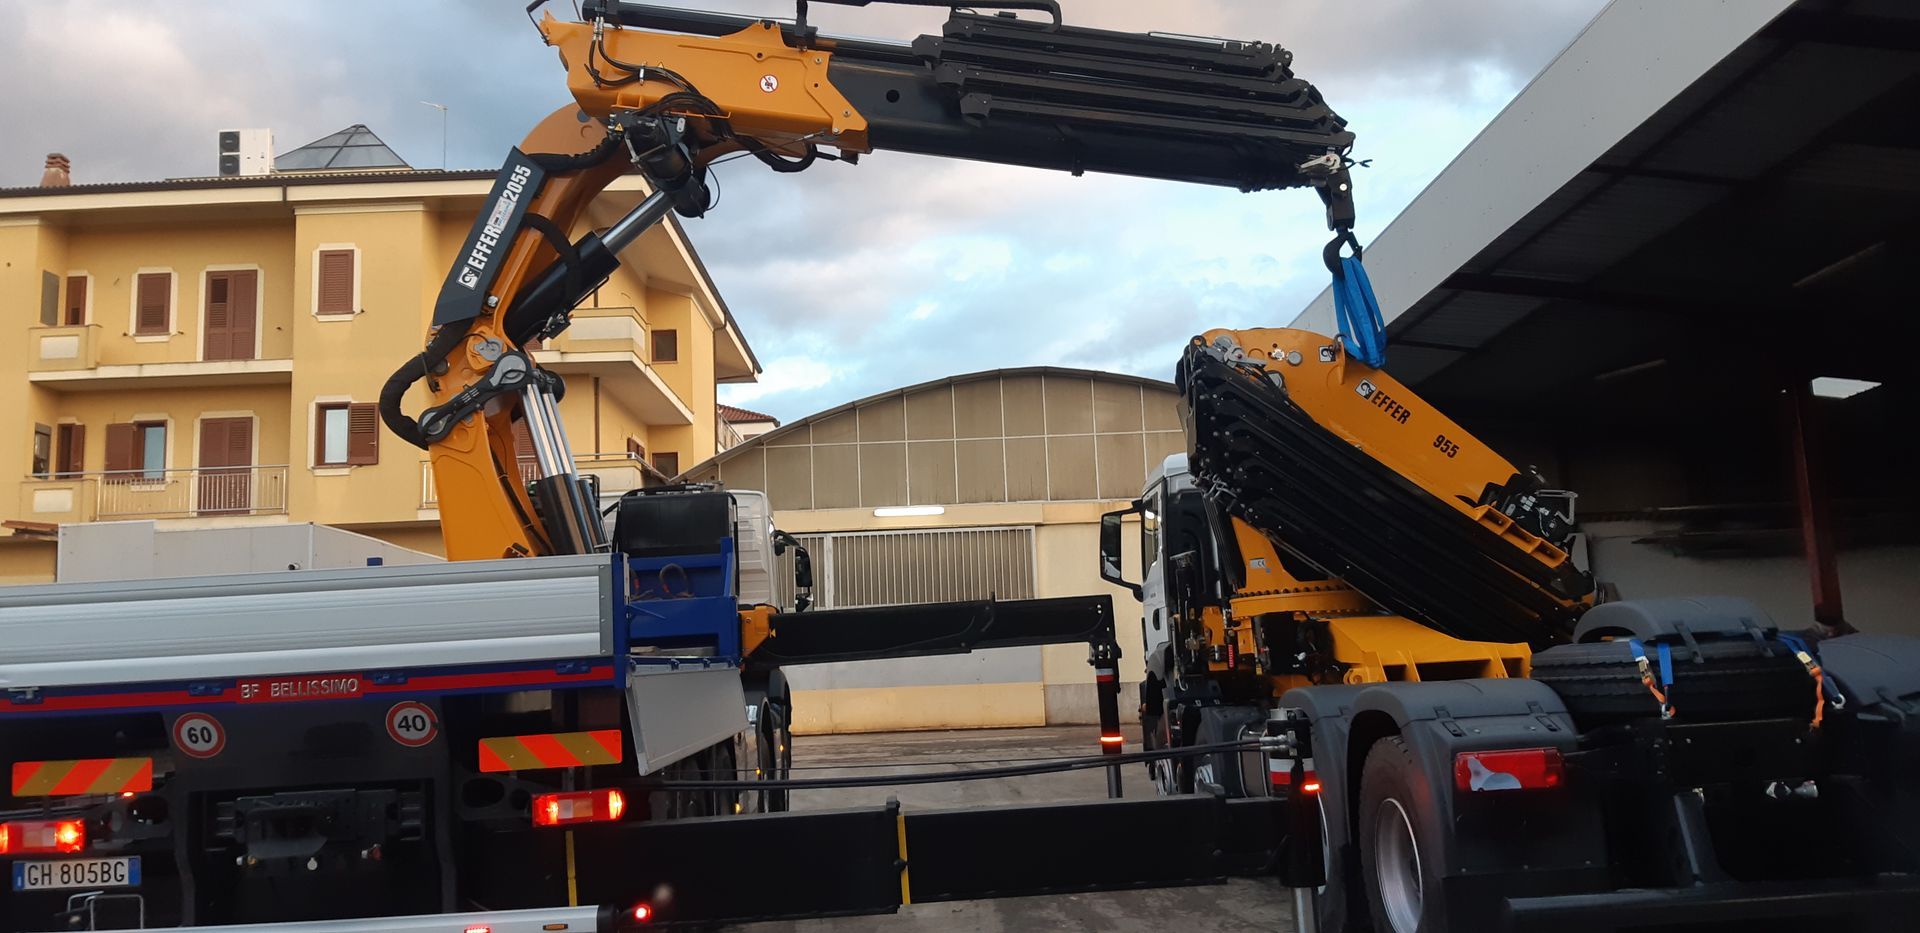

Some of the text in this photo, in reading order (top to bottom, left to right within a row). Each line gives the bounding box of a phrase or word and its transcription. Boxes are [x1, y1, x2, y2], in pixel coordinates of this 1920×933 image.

[467, 224, 502, 270] EFFER
[502, 165, 531, 202] 2055
[1371, 390, 1411, 424] EFFER
[1433, 434, 1459, 458] 955
[241, 678, 358, 698] BF BELLISSIMO
[187, 726, 212, 744] 60
[397, 714, 426, 732] 40
[28, 864, 52, 886] GH
[60, 861, 125, 885] 805BG
